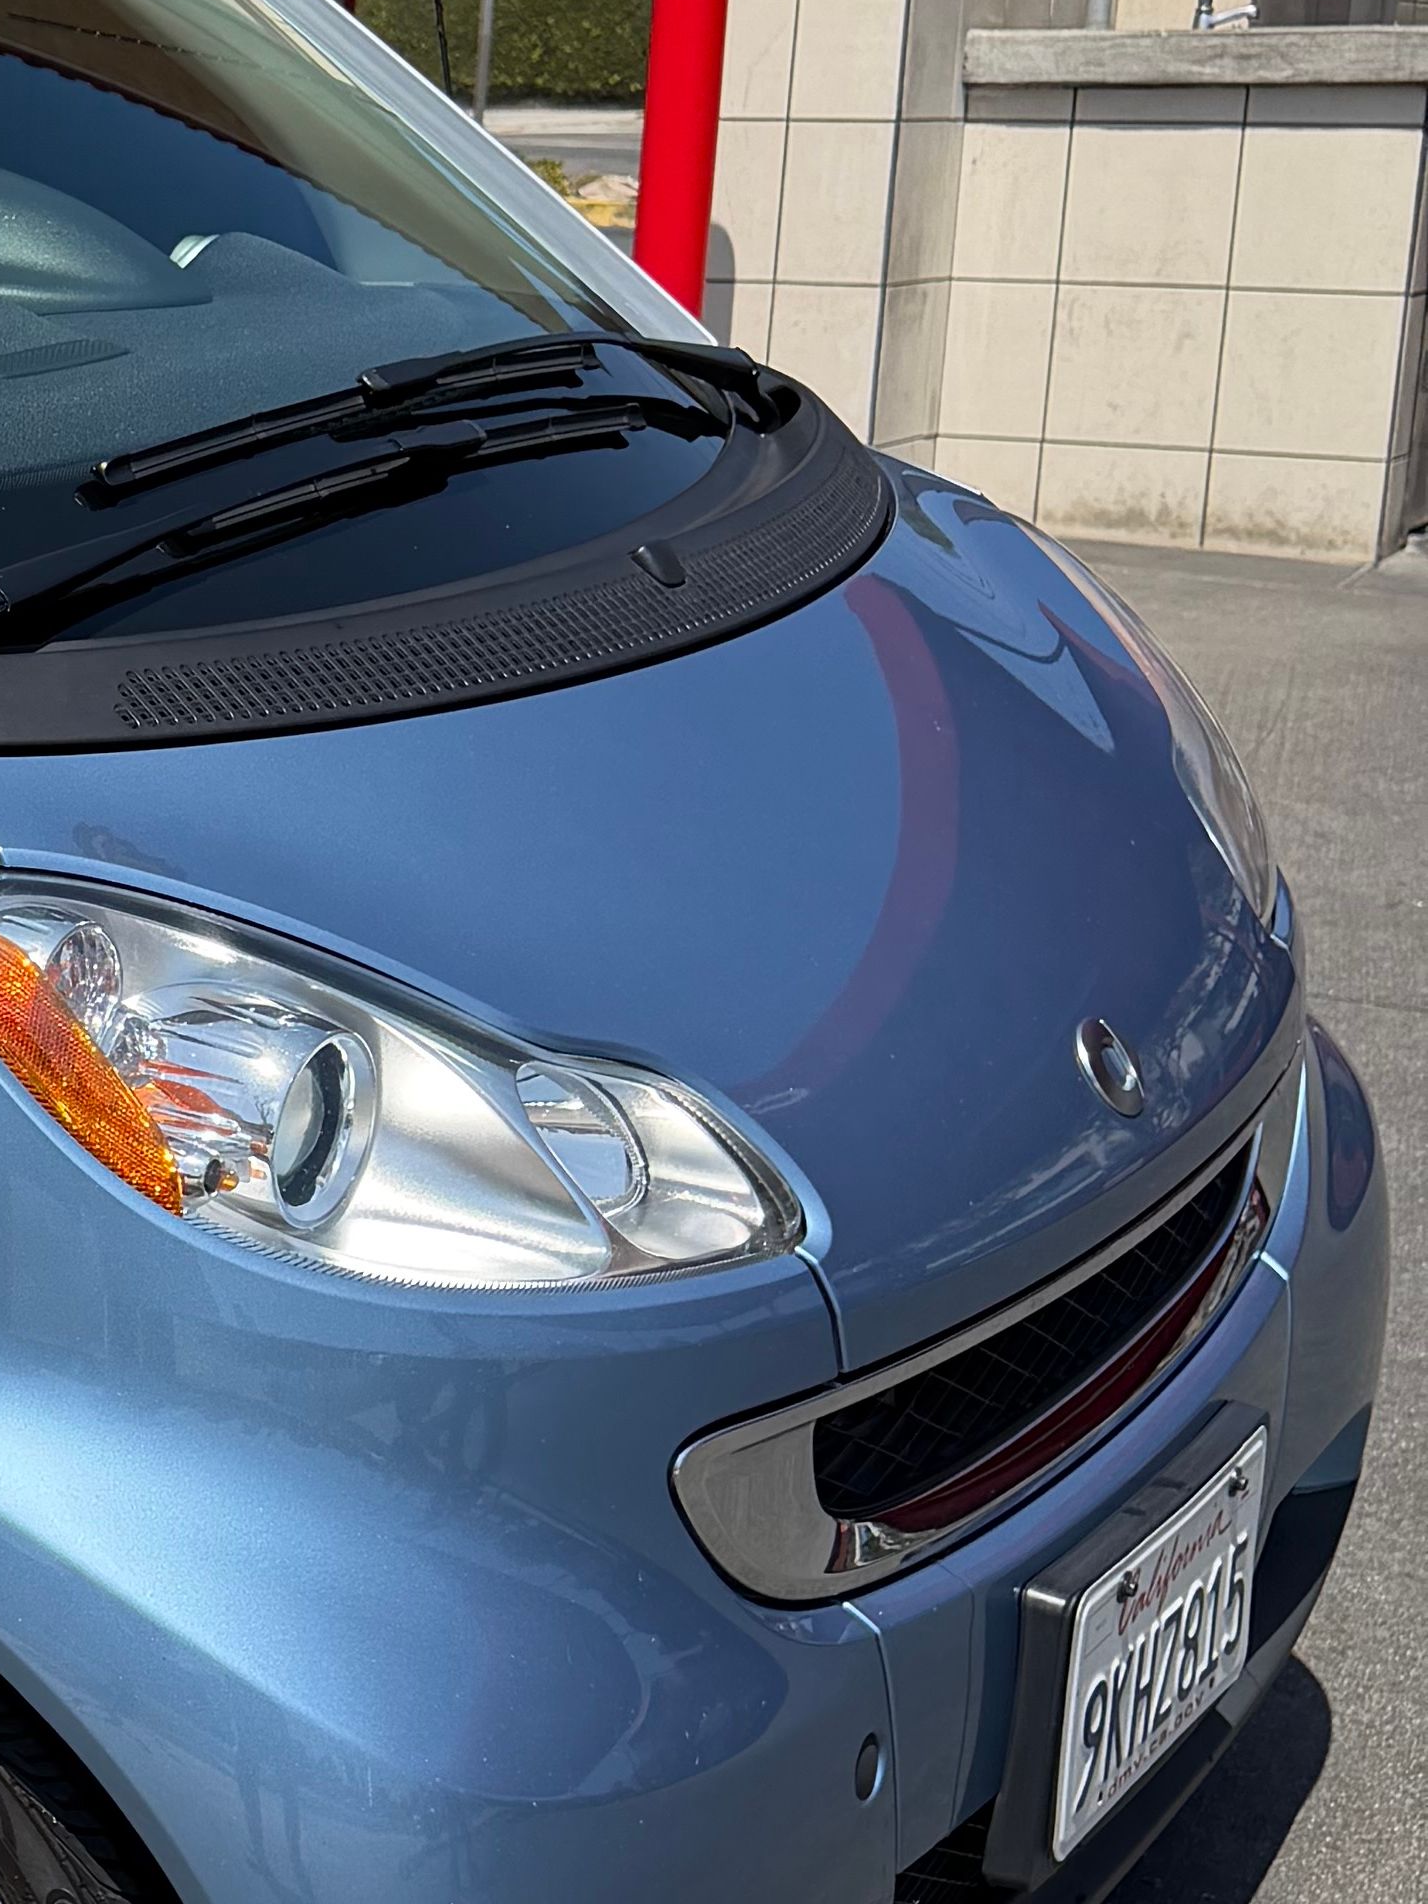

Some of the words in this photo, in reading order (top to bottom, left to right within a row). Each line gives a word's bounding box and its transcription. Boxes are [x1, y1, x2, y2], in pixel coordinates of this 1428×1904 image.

[1118, 1509, 1232, 1636] California
[1073, 1530, 1249, 1814] 9KHZ815
[1107, 1690, 1204, 1800] dmv.ca.gov
